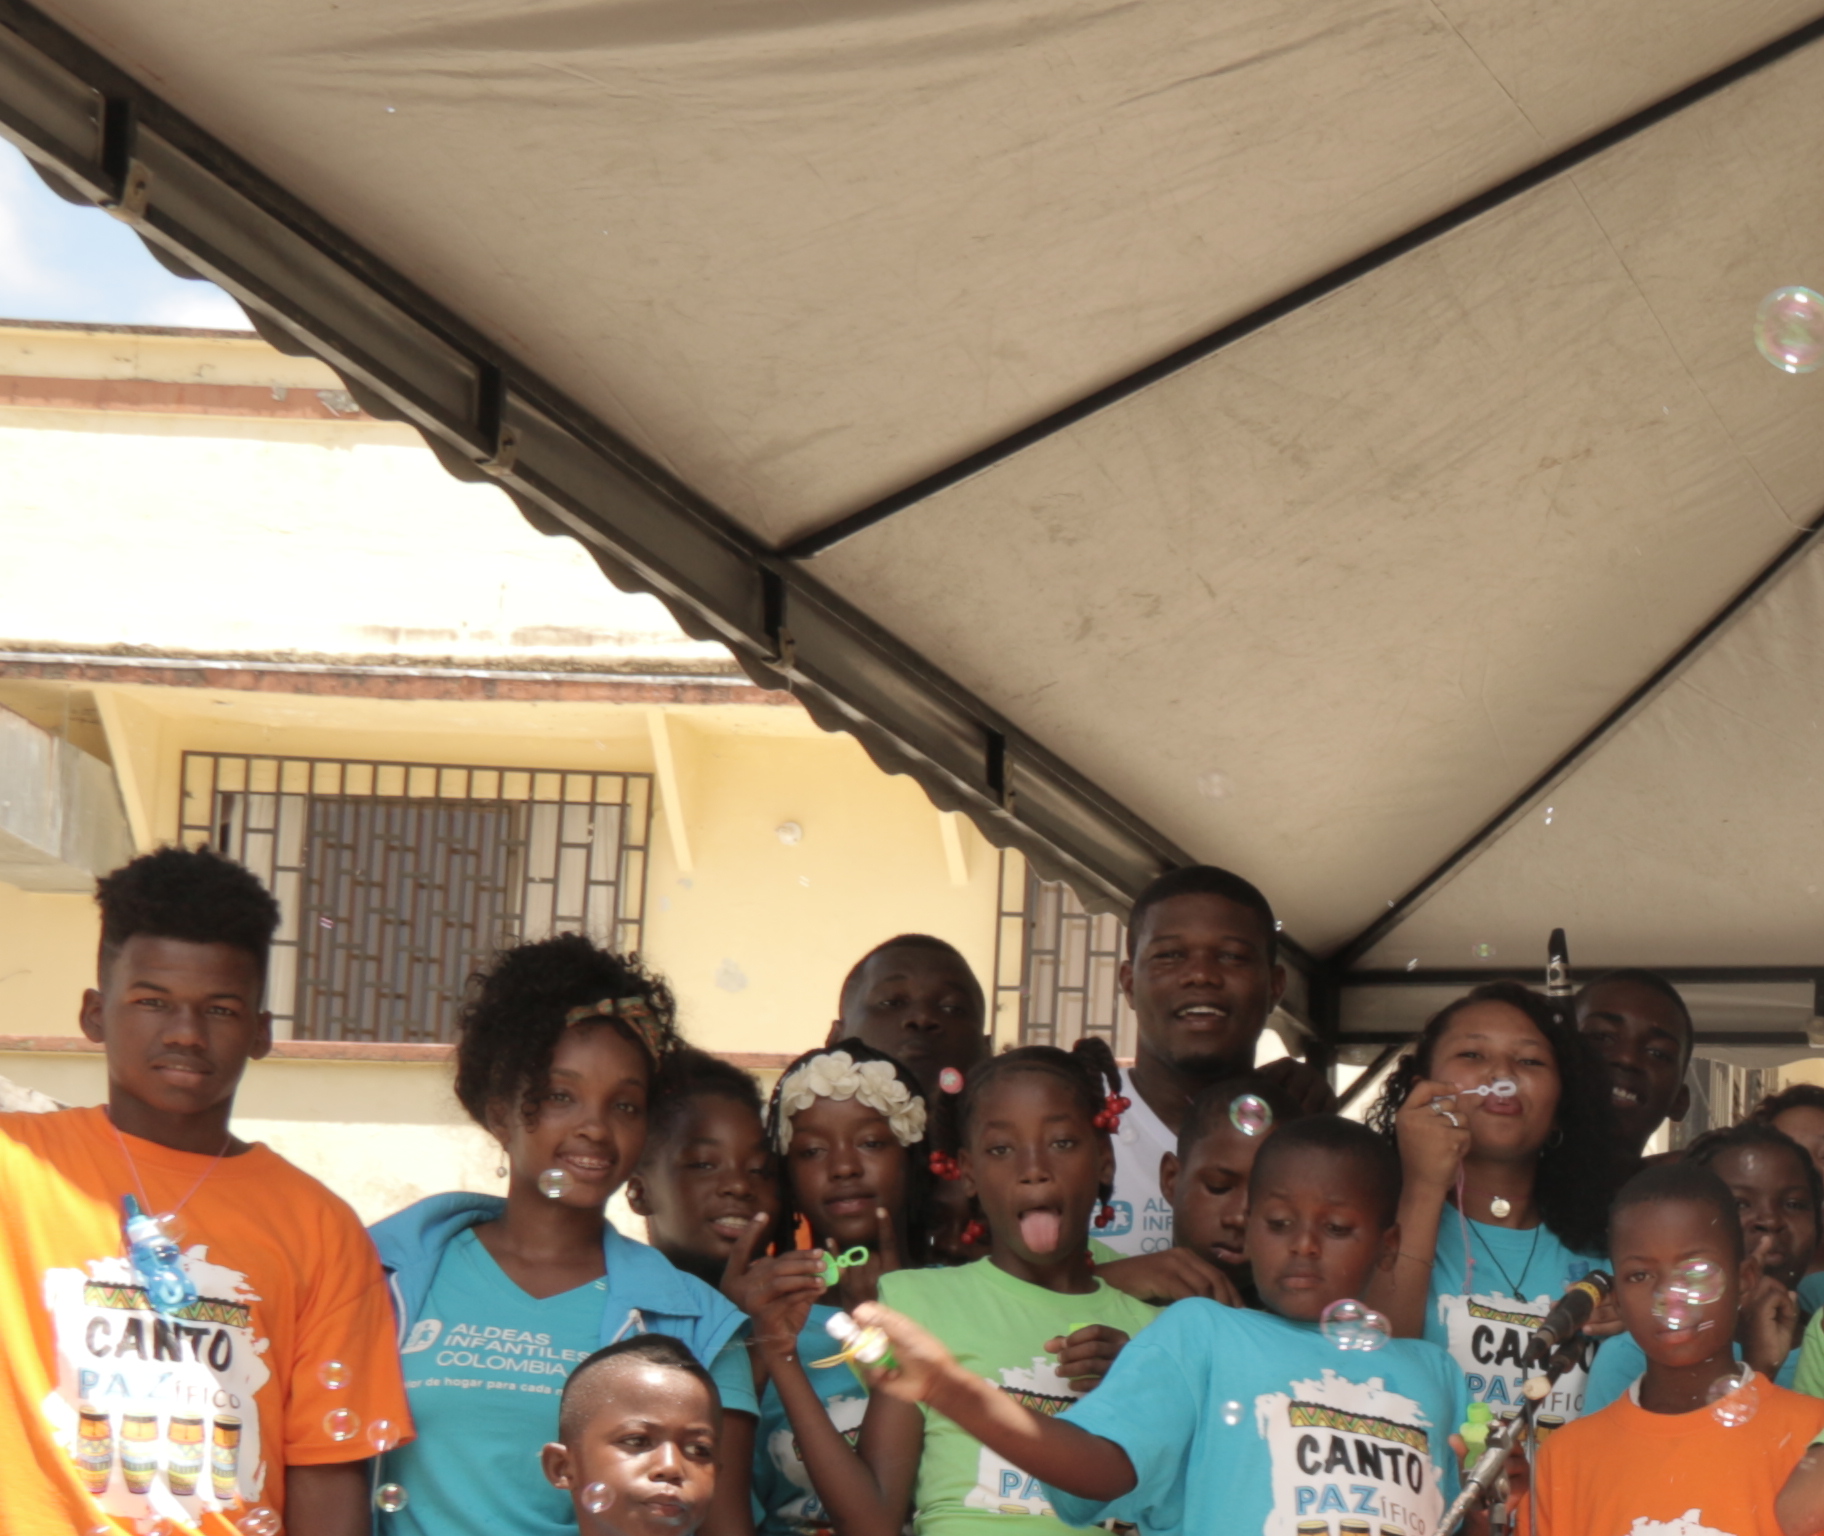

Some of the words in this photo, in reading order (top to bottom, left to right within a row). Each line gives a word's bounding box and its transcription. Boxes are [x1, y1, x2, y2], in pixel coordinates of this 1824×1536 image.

[85, 1315, 233, 1372] CANTO
[451, 1322, 552, 1346] ALDEAS
[443, 1335, 592, 1363] INFANTILES
[436, 1350, 569, 1379] COLOMBIA
[486, 1379, 518, 1391] para
[1297, 1434, 1422, 1495] CANTO
[1295, 1483, 1426, 1536] PAZÍFICO
